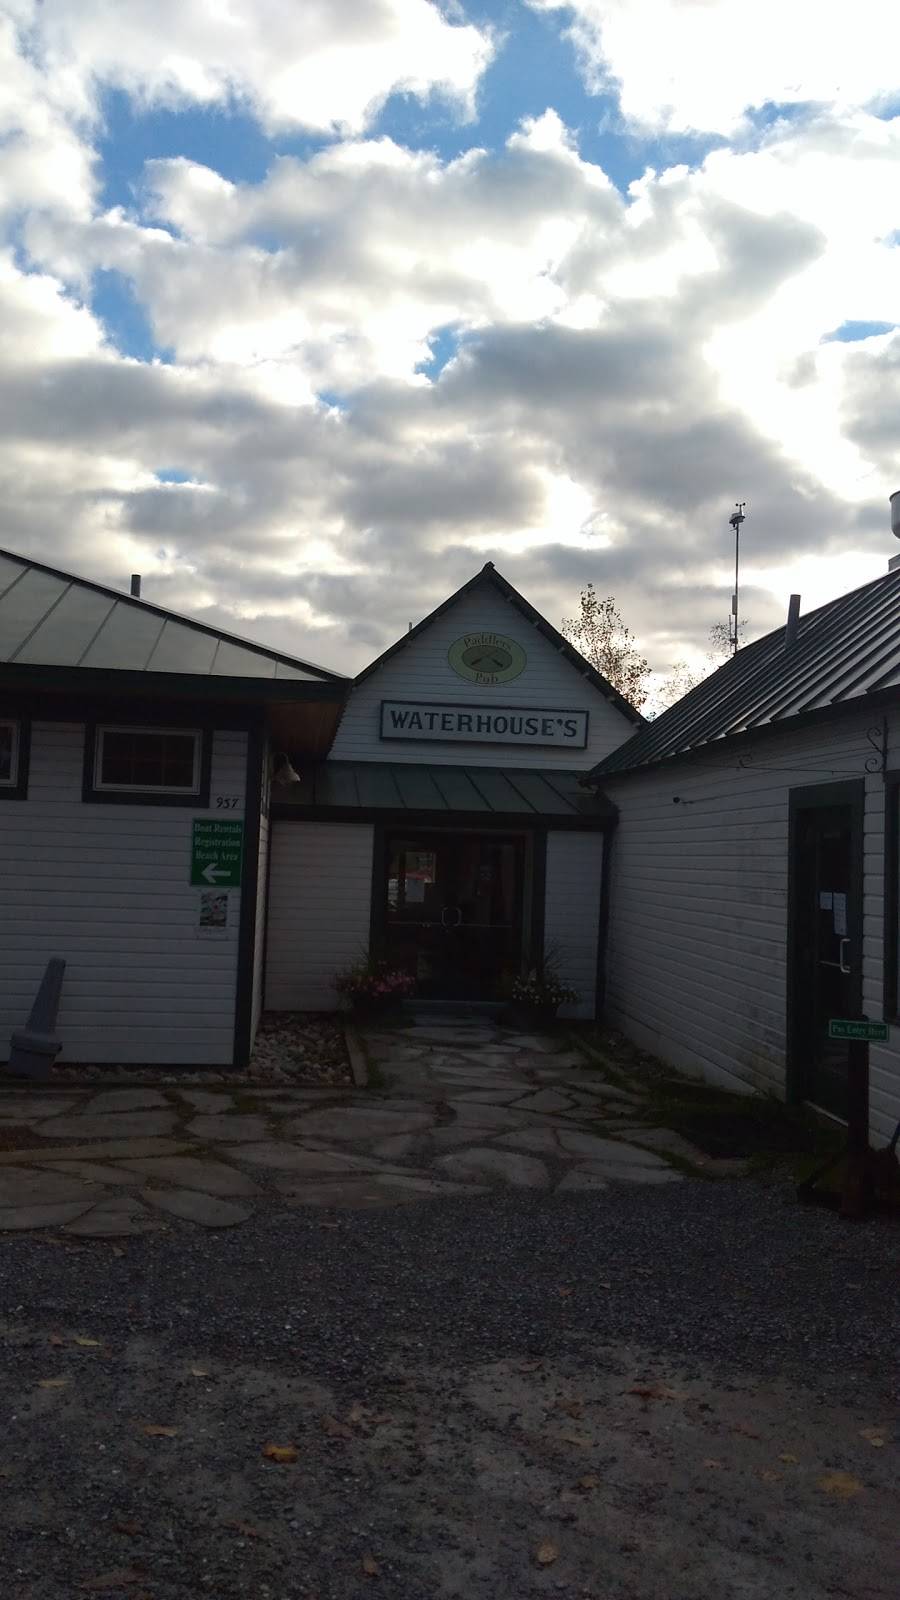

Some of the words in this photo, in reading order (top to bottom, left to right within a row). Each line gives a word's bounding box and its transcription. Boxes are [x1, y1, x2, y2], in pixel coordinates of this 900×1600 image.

[475, 672, 498, 684] Pub
[390, 710, 578, 738] WATERHOUSE'S
[194, 823, 212, 833] Boat
[214, 823, 242, 833] Rentals
[194, 836, 242, 848] Registration
[195, 849, 218, 860] Beach
[221, 851, 239, 861] Area
